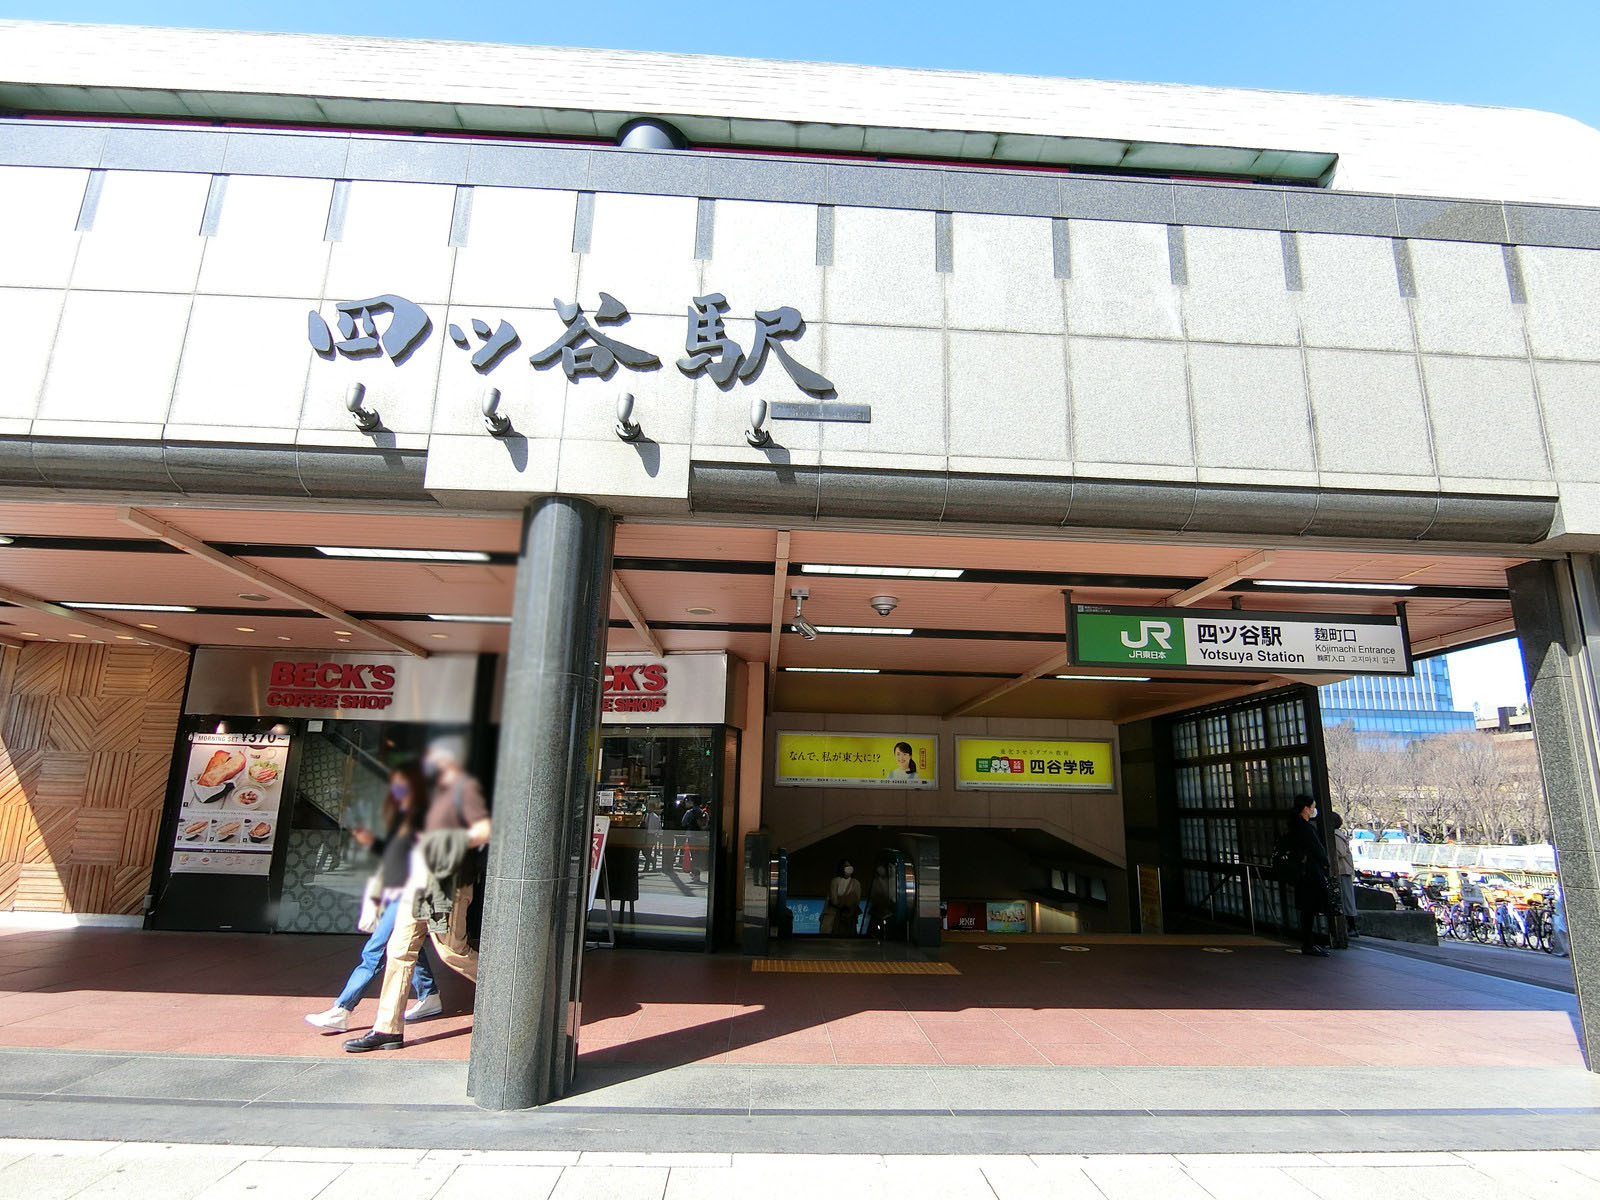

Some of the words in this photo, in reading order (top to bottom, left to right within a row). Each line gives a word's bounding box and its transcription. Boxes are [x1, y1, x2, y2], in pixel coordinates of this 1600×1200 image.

[308, 286, 839, 398] 四ツ谷駅
[1120, 620, 1172, 649] JR
[1197, 624, 1283, 646] 四ツ谷駅
[1128, 650, 1167, 660] JR東日本
[1200, 648, 1253, 663] Yotsuya
[1257, 650, 1305, 663] Station
[1358, 646, 1396, 654] Entrance
[270, 661, 395, 690] BECK'S
[267, 692, 339, 709] COFFEE
[340, 694, 392, 710] SHOP
[614, 697, 667, 712] SHOP
[1030, 759, 1095, 775] 四谷学院
